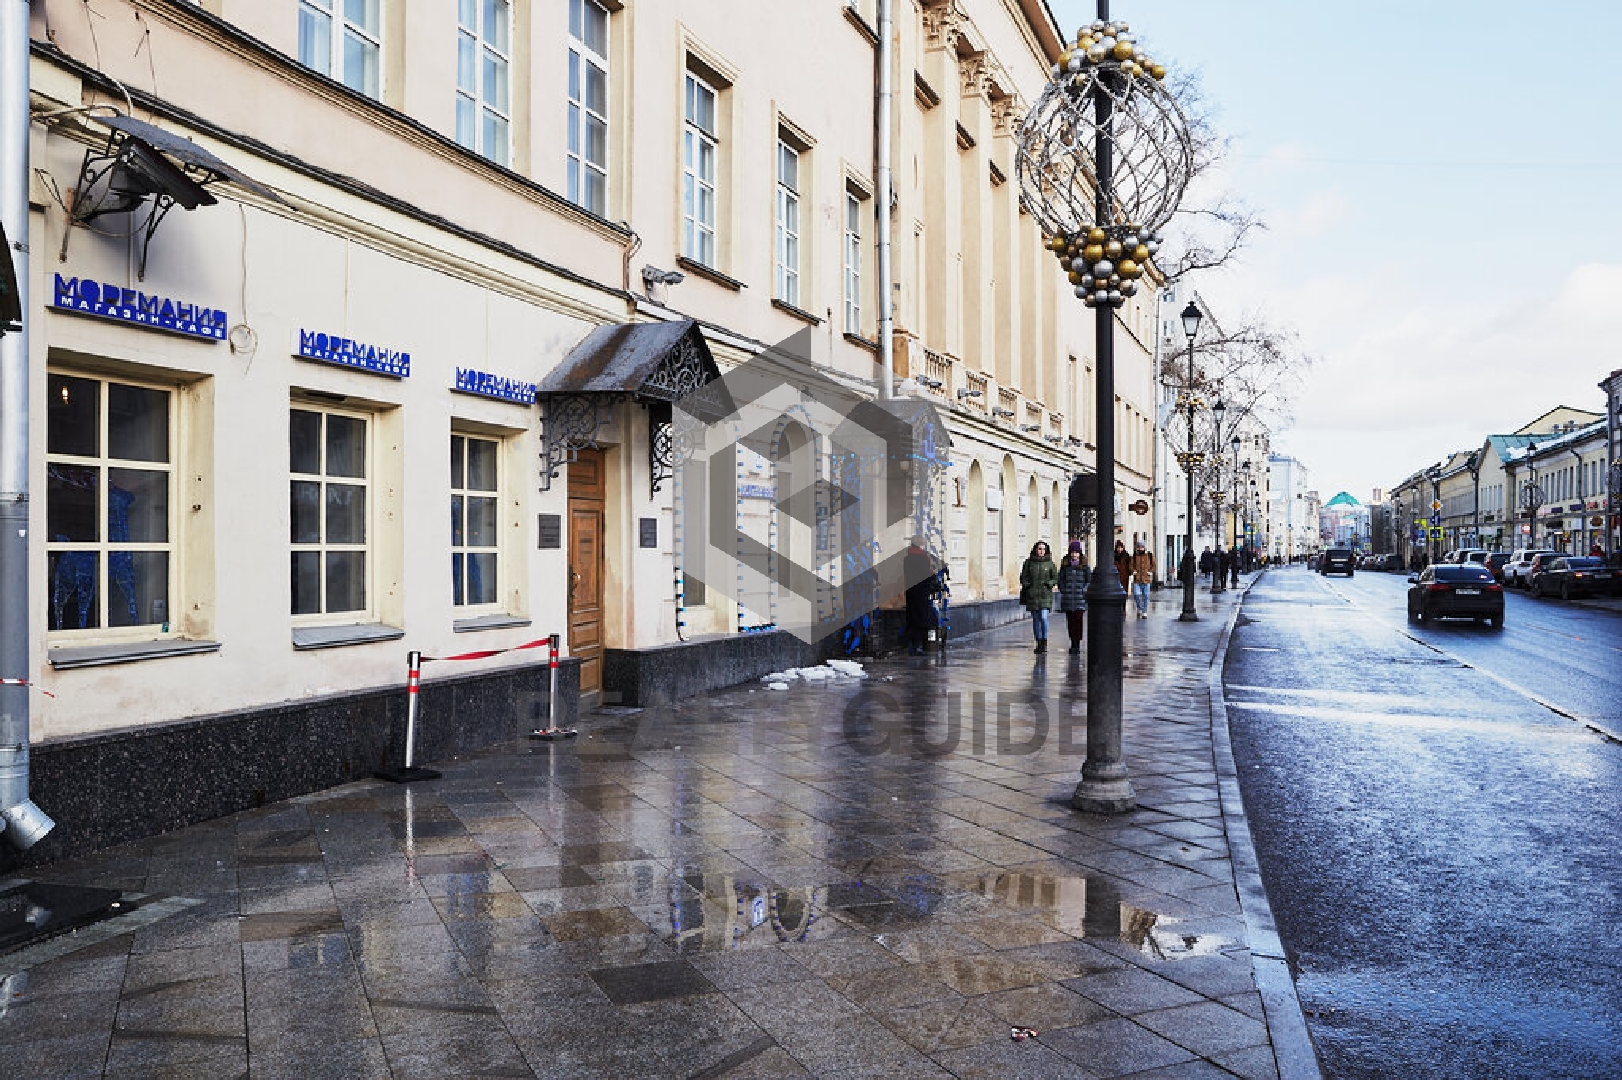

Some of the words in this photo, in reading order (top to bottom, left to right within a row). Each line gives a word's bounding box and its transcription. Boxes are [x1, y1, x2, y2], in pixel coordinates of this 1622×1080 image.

[54, 273, 227, 328] МОРЕМАНИЯ
[61, 296, 223, 338] МАГАЗИН-КАФЕ
[301, 329, 410, 368] МОРЕМАНИЯ
